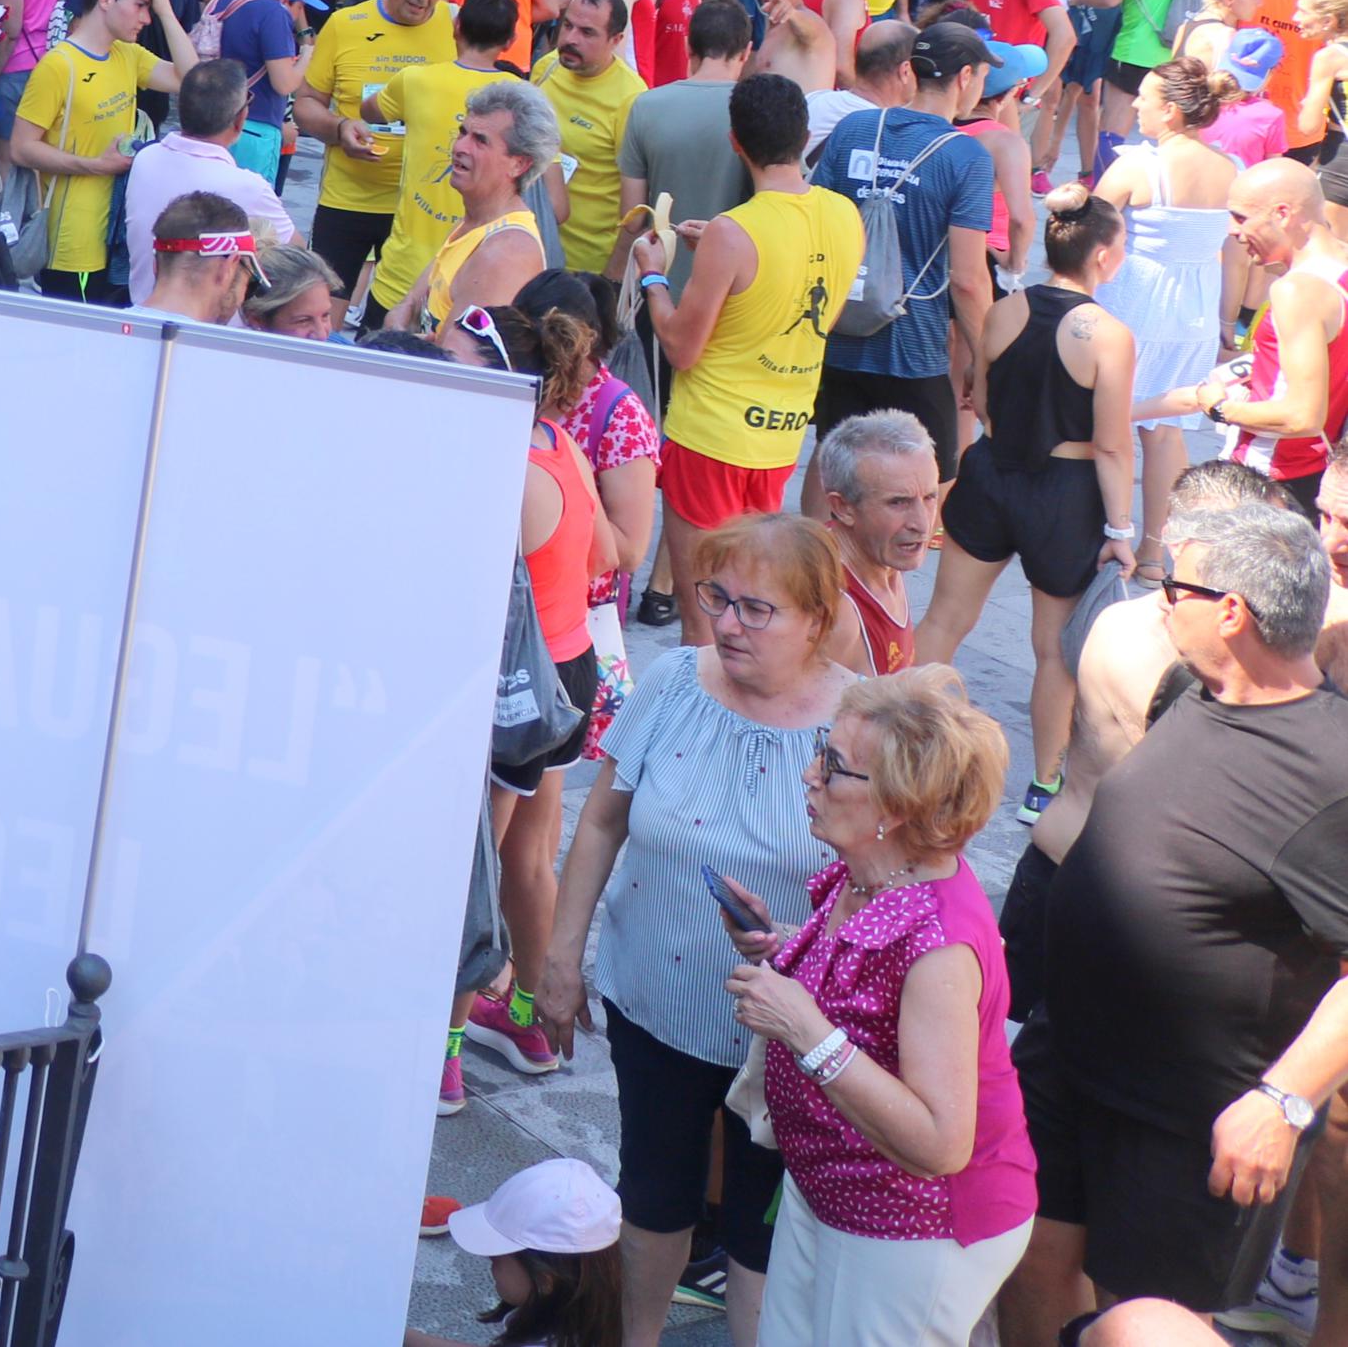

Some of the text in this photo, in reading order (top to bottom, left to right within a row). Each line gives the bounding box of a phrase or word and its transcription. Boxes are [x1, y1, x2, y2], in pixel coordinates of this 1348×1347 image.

[412, 191, 433, 216] Villa
[434, 212, 448, 222] de
[757, 353, 778, 372] Villa
